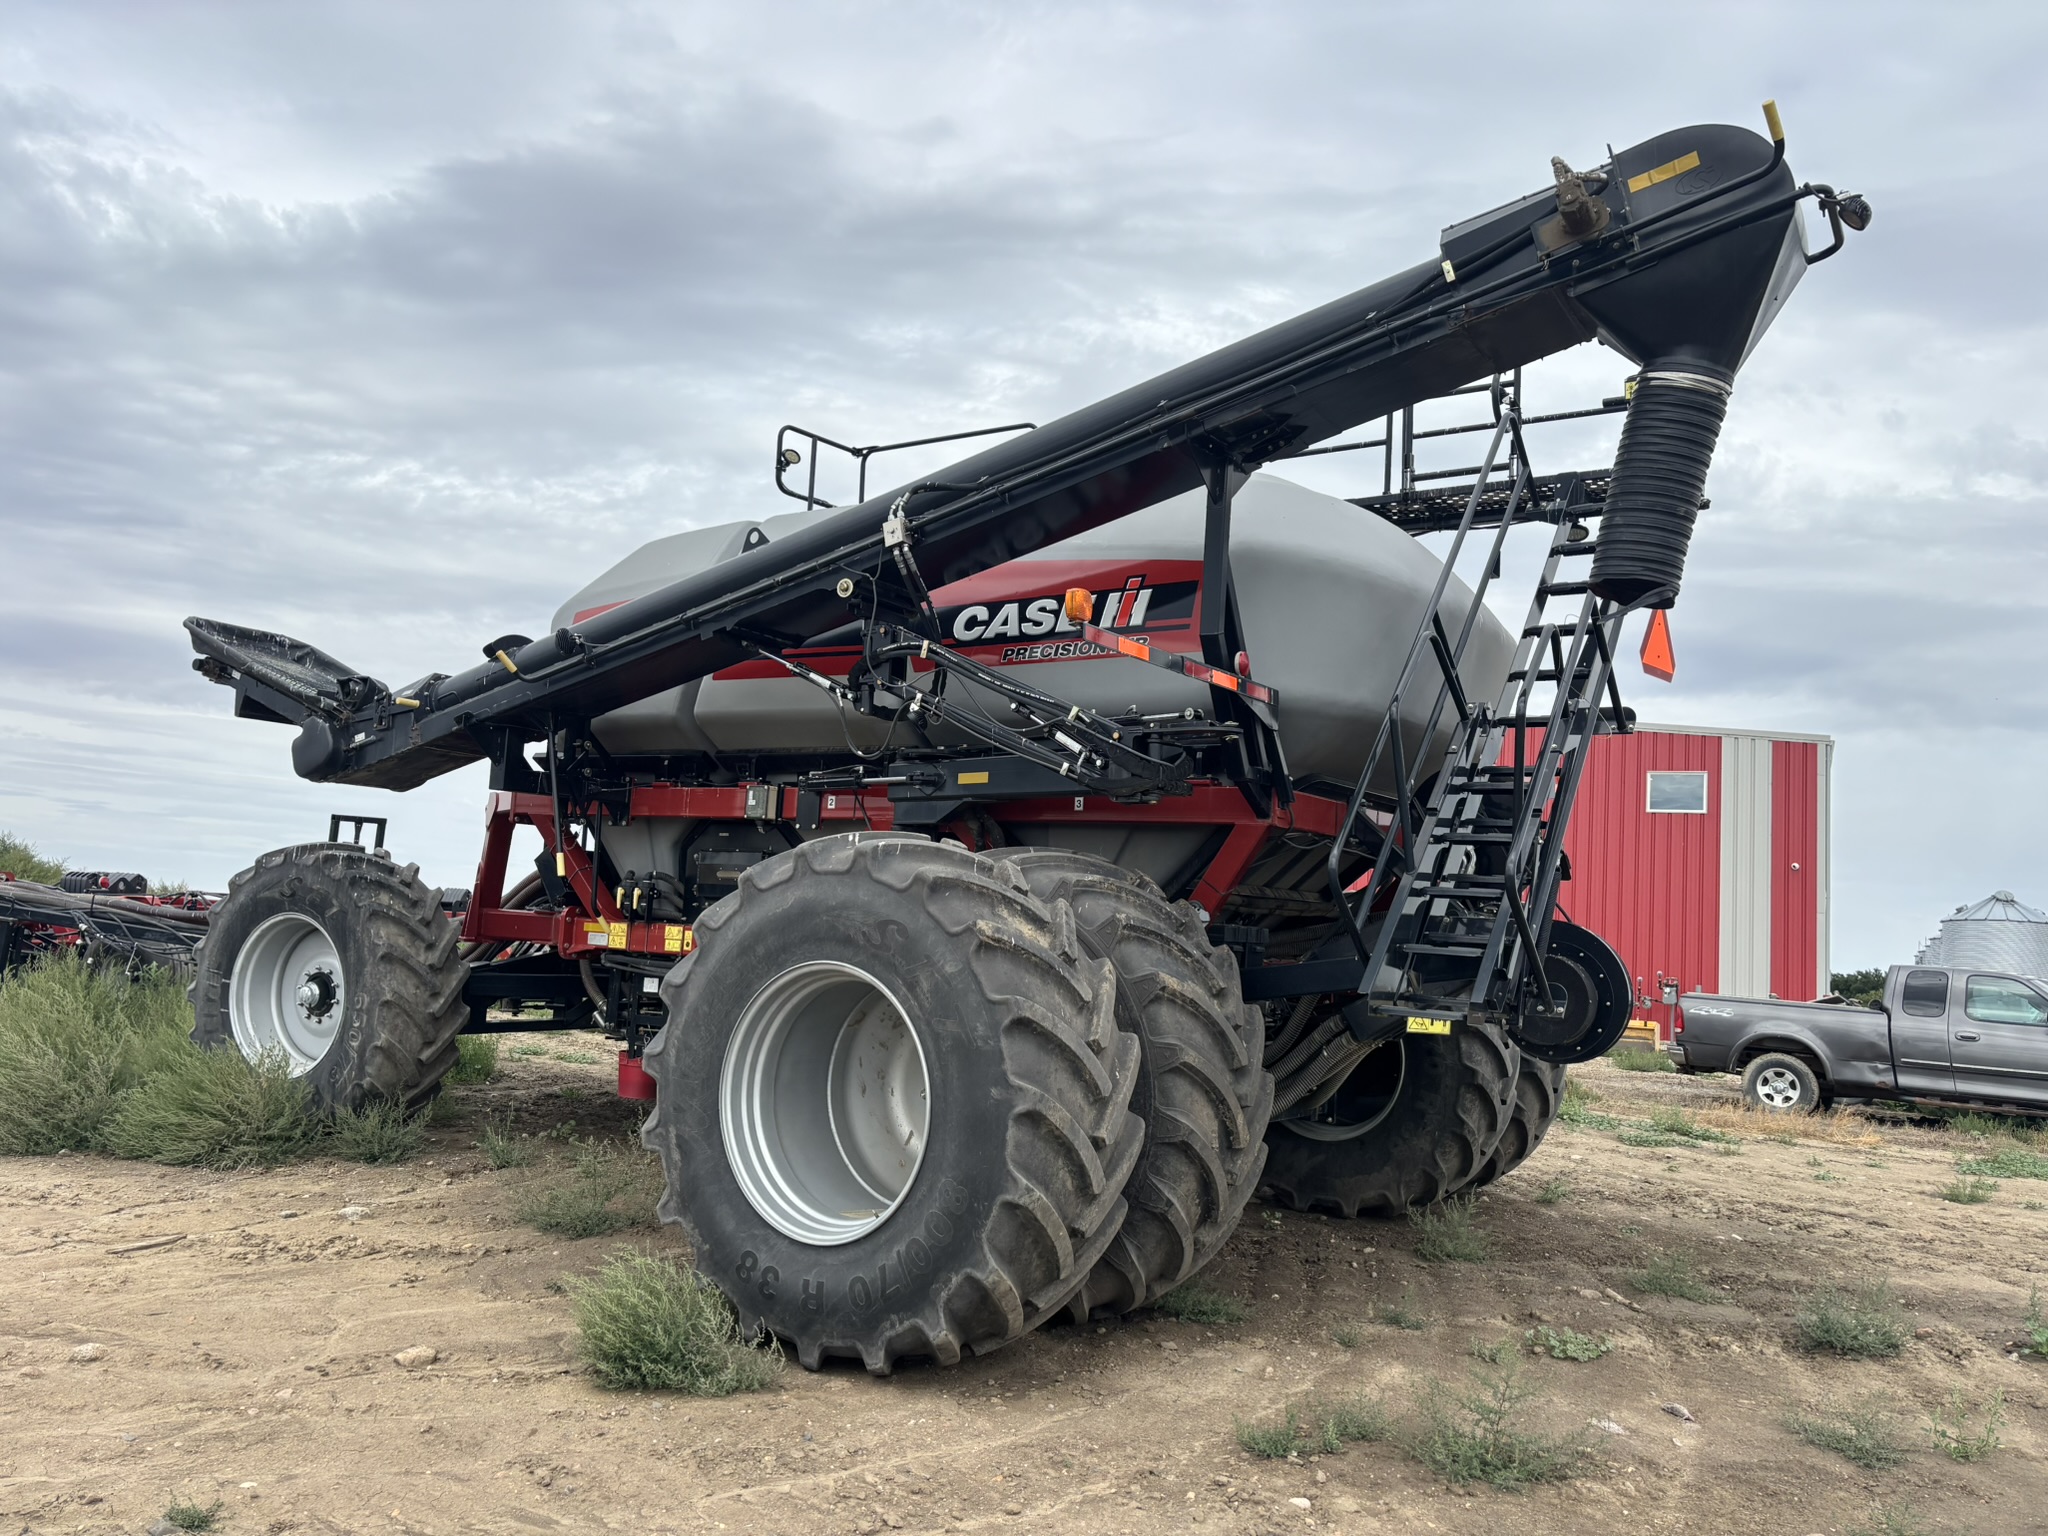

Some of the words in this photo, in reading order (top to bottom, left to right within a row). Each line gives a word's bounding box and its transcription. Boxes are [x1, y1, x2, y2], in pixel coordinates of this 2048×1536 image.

[1001, 640, 1108, 662] PRECISION
[848, 1178, 969, 1312] 800/70
[735, 1249, 780, 1300] 38
[800, 1278, 826, 1313] R
